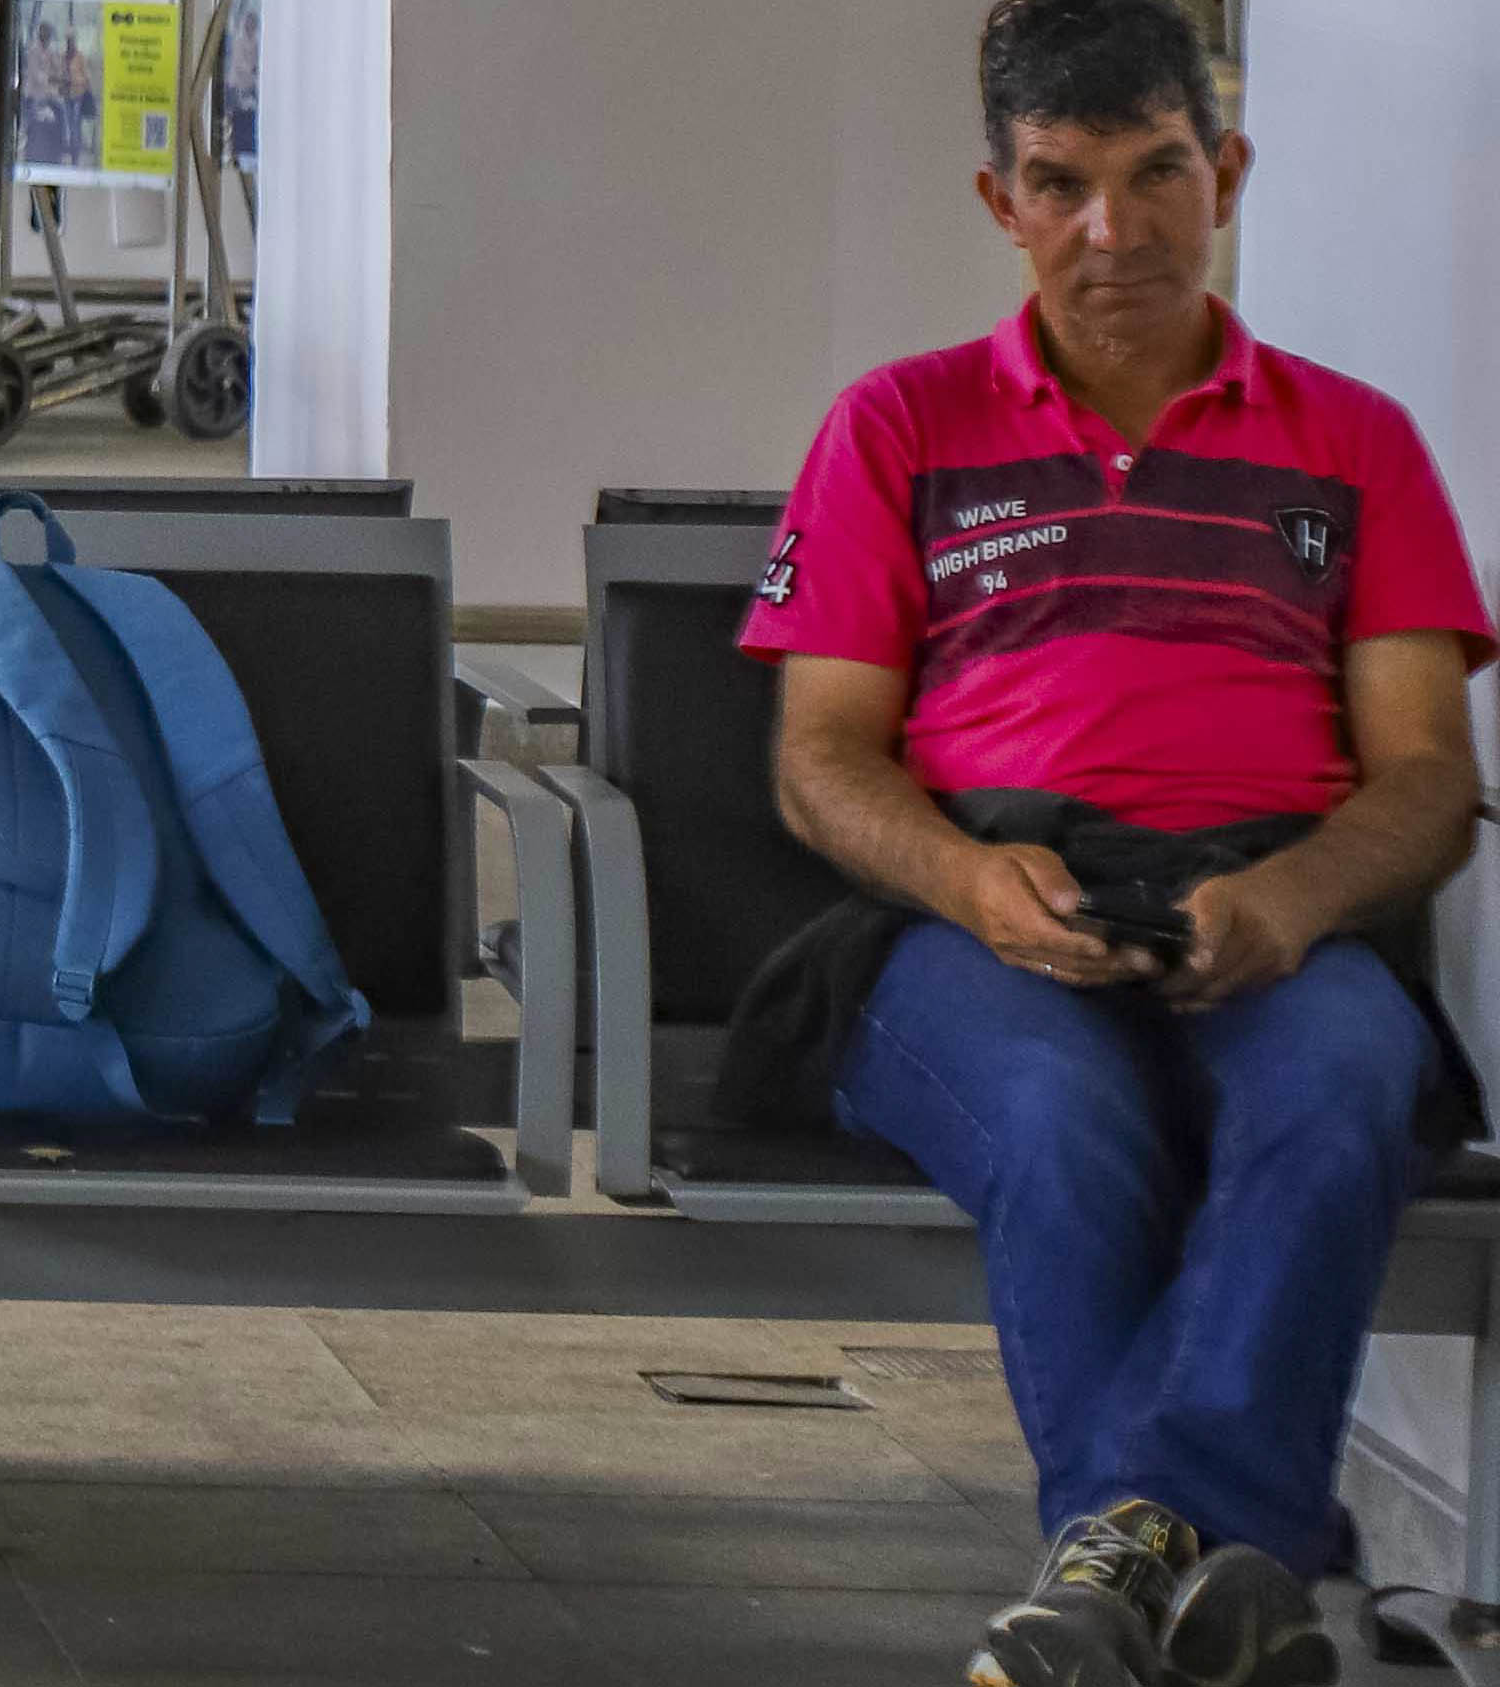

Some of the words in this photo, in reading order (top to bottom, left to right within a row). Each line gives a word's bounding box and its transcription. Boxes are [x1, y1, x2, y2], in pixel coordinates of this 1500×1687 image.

[957, 499, 1027, 529] WAVE
[931, 546, 979, 582] HIGH
[982, 525, 1068, 562] BRAND
